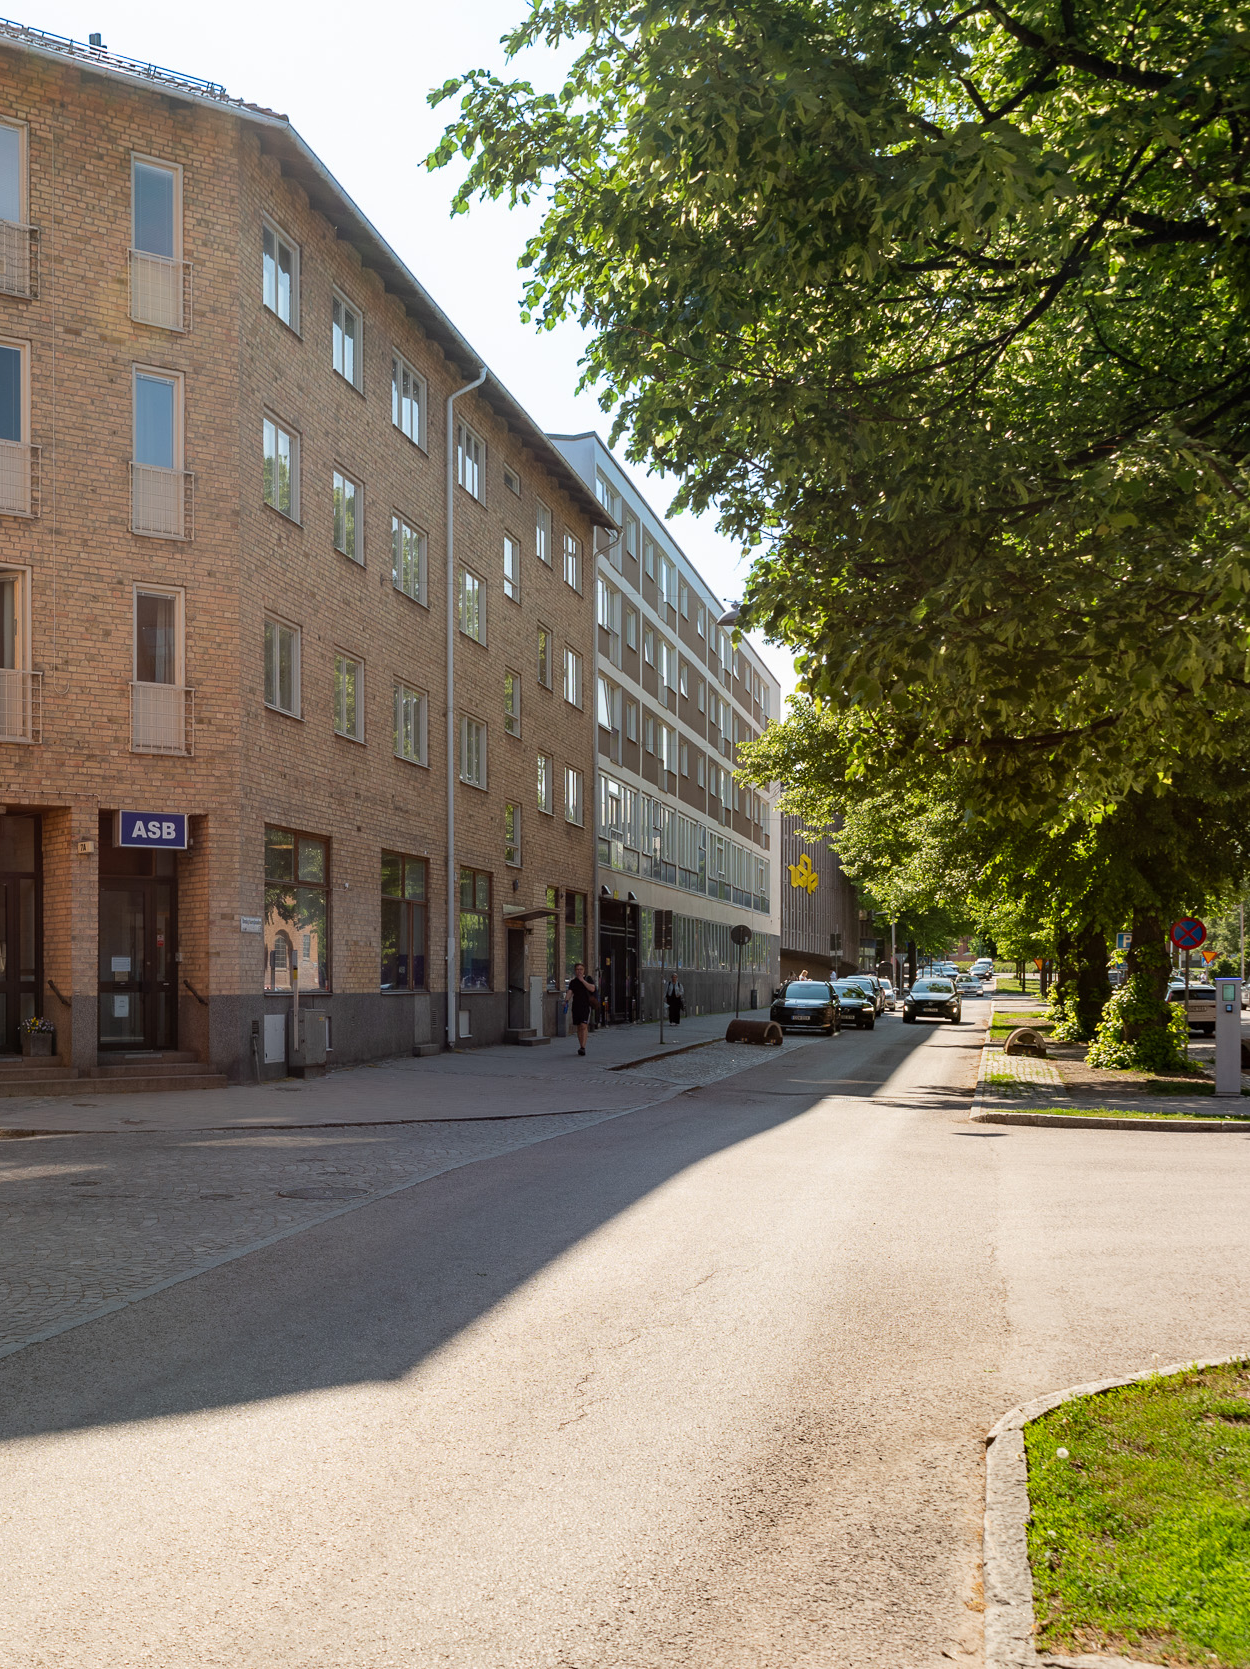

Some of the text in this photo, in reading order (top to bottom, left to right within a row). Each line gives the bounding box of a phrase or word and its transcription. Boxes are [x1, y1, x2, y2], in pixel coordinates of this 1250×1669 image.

[132, 820, 176, 839] ASB
[80, 843, 86, 852] 7A
[1123, 935, 1132, 947] P
